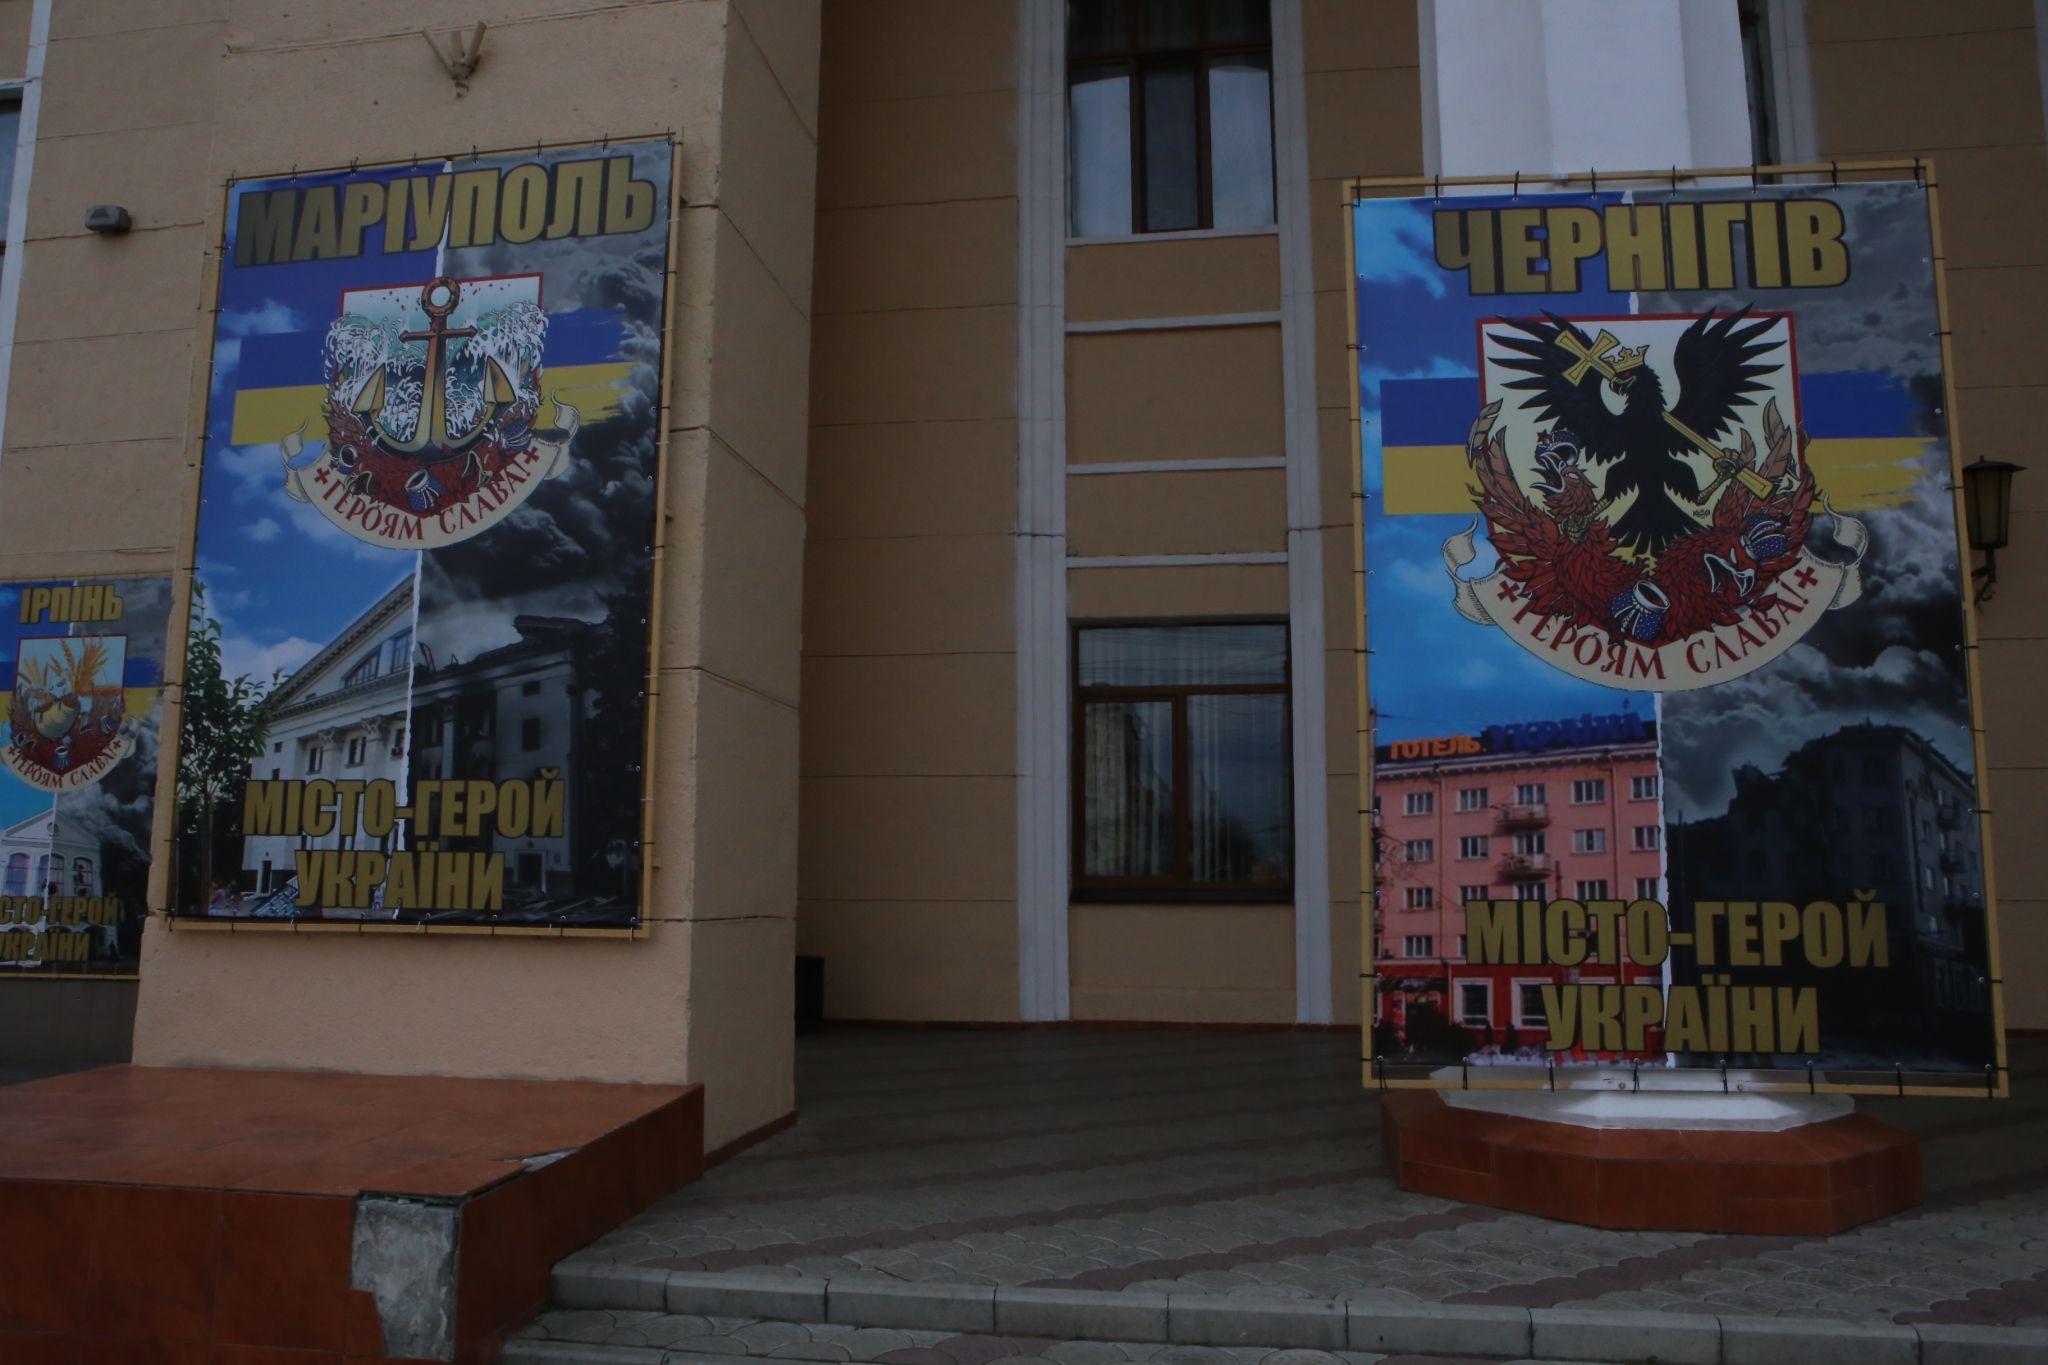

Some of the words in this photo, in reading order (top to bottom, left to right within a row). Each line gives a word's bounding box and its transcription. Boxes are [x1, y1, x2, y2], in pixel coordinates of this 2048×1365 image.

[234, 155, 657, 267] МАРІУПОЛЬ
[1432, 198, 1851, 295] ЧЕРНІГІВ
[322, 479, 425, 540] ГЕРОЯМ
[439, 460, 532, 534] СЛАВА!
[20, 584, 124, 624] ІРПІНЬ
[1513, 600, 1667, 680] ГЕРОЯМ
[1686, 579, 1810, 673] СЛАВА!
[1390, 735, 1483, 761] ГОТЕЛЬ
[242, 767, 566, 838] МІСТО-ГЕРОЙ
[295, 841, 505, 910] УКРАЇНИ
[1466, 889, 1889, 968] МІСТО-ГЕРОЙ
[1541, 973, 1821, 1054] УКРАЇНИ
